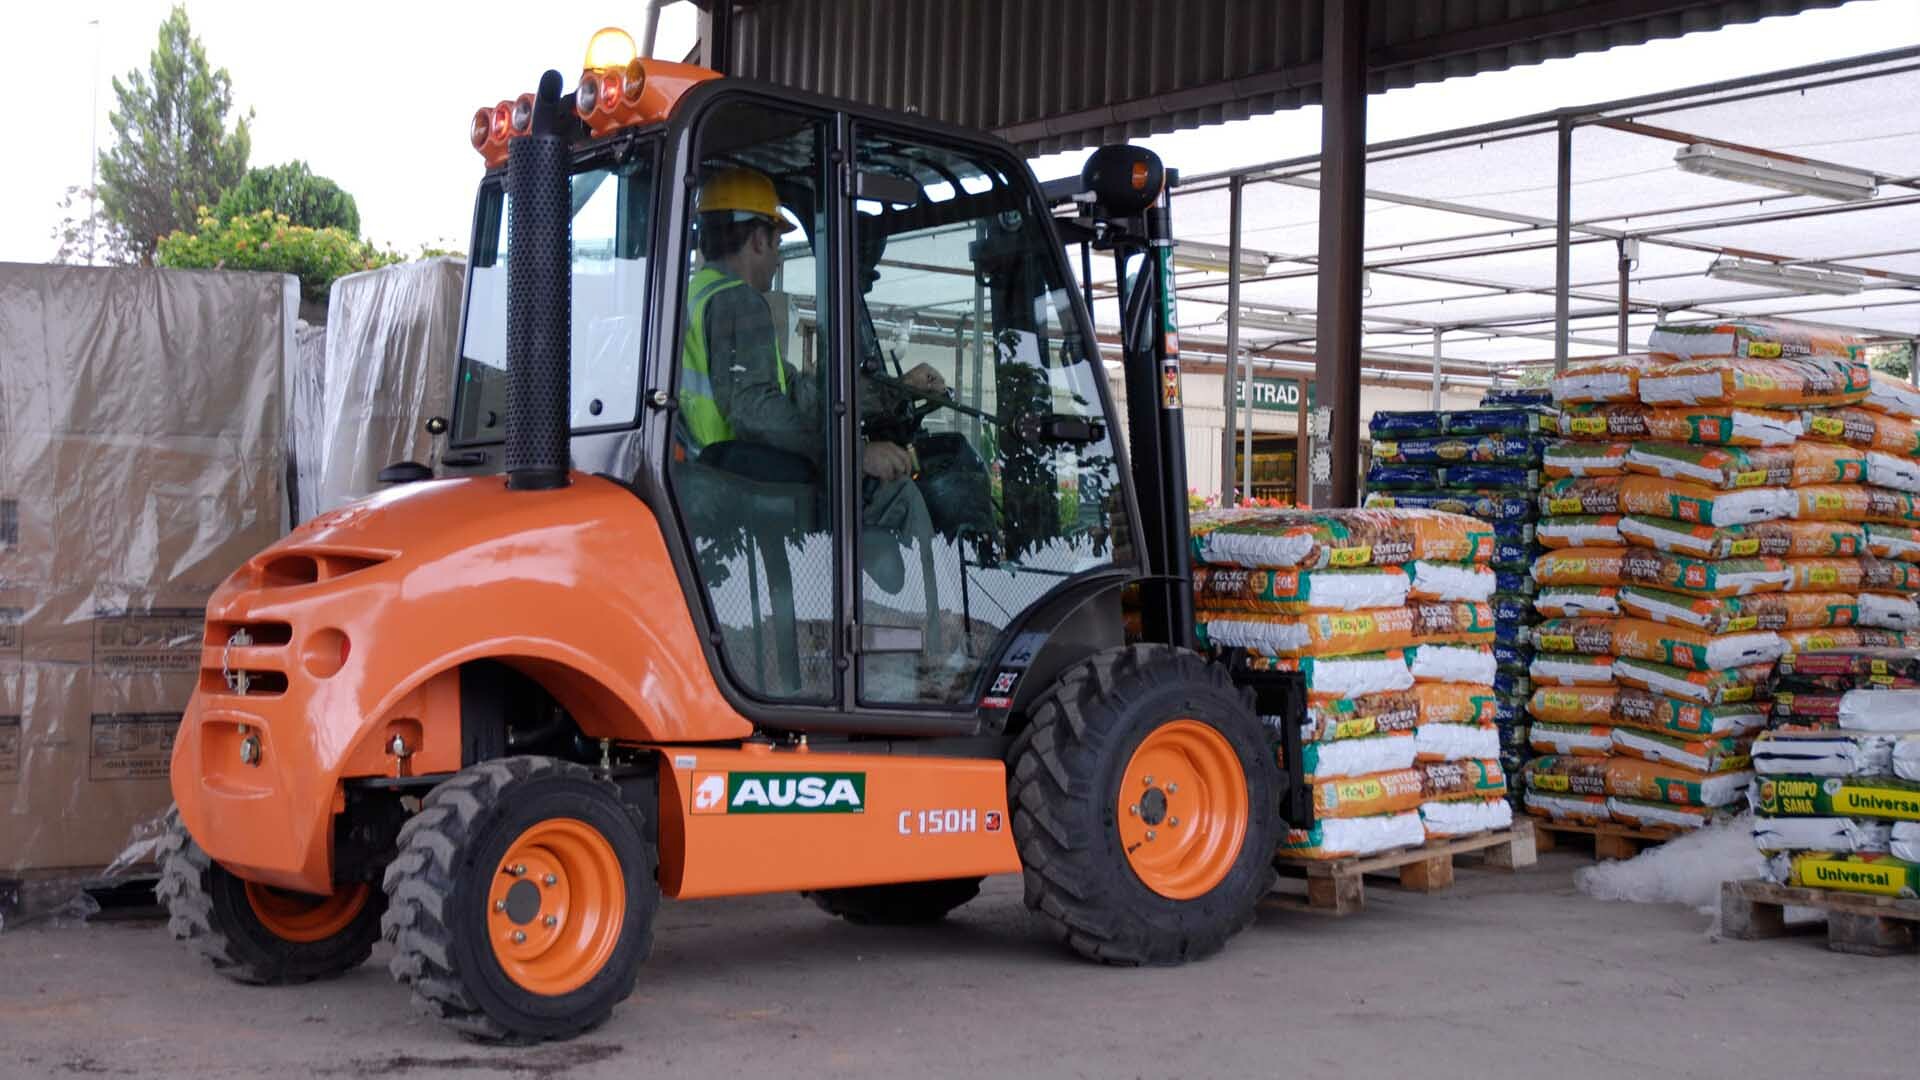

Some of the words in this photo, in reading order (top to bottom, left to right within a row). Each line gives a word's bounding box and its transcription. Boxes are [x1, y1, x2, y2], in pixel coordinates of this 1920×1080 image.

[1236, 380, 1310, 408] ETRAD
[732, 777, 861, 808] AUSA
[1778, 781, 1817, 797] COMPO
[898, 810, 912, 834] C
[918, 808, 977, 835] 150H
[1816, 866, 1890, 885] Universal
